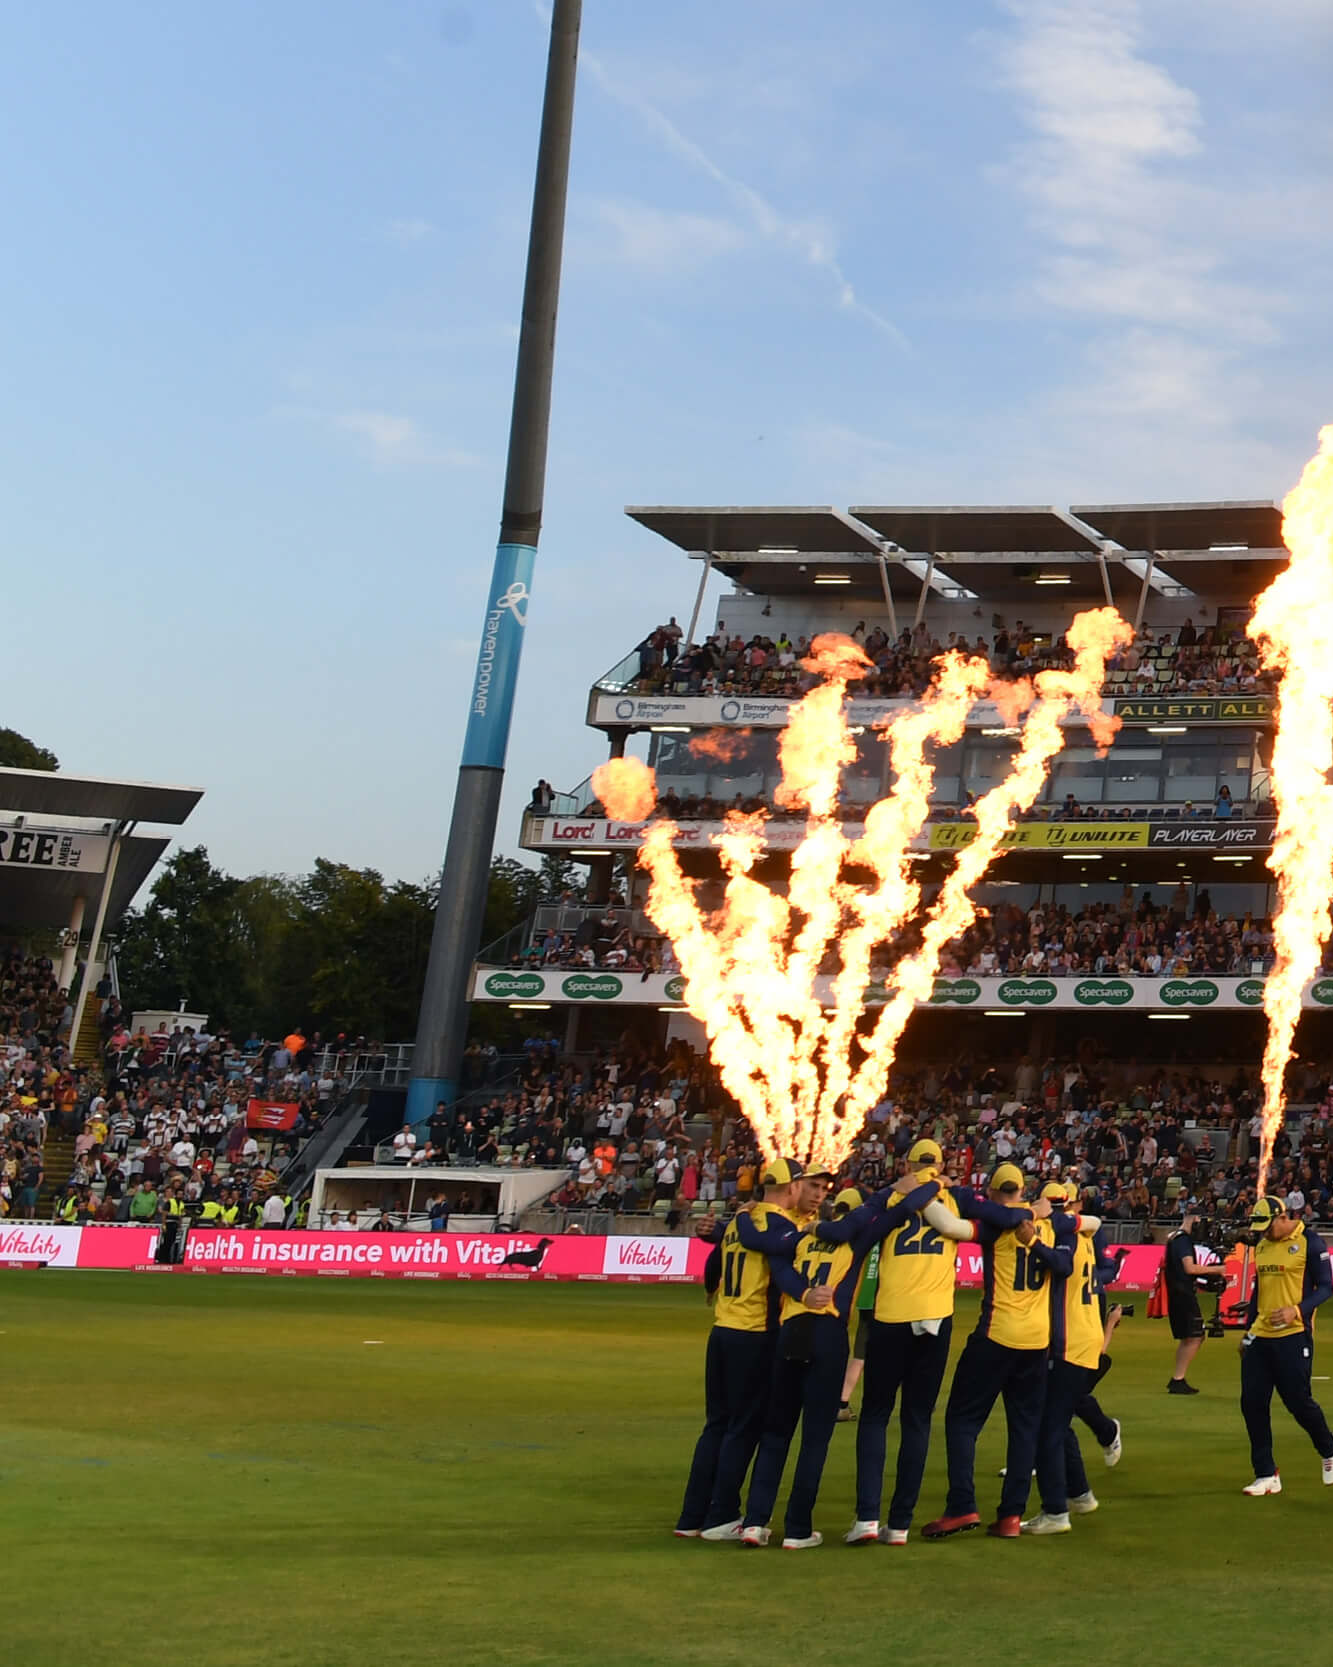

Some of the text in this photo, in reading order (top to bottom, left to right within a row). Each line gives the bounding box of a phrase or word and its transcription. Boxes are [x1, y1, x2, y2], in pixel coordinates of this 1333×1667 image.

[1120, 704, 1213, 717] ALLETT
[1070, 829, 1142, 843] UNILITE
[1153, 829, 1257, 842] PLAYERLAYER
[57, 835, 73, 868] AMBER
[68, 848, 82, 868] ALE
[490, 977, 541, 991] Specsavers
[567, 979, 617, 993] Specsavers
[1003, 986, 1052, 999] Specsavers
[1079, 986, 1129, 999] Specsavers
[1165, 986, 1214, 999] Specsavers
[894, 1215, 944, 1257] 22
[252, 1237, 382, 1264] insurance
[390, 1239, 449, 1265] with
[619, 1240, 673, 1274] Vitality
[724, 1251, 747, 1297] 11
[1013, 1246, 1044, 1292] 16
